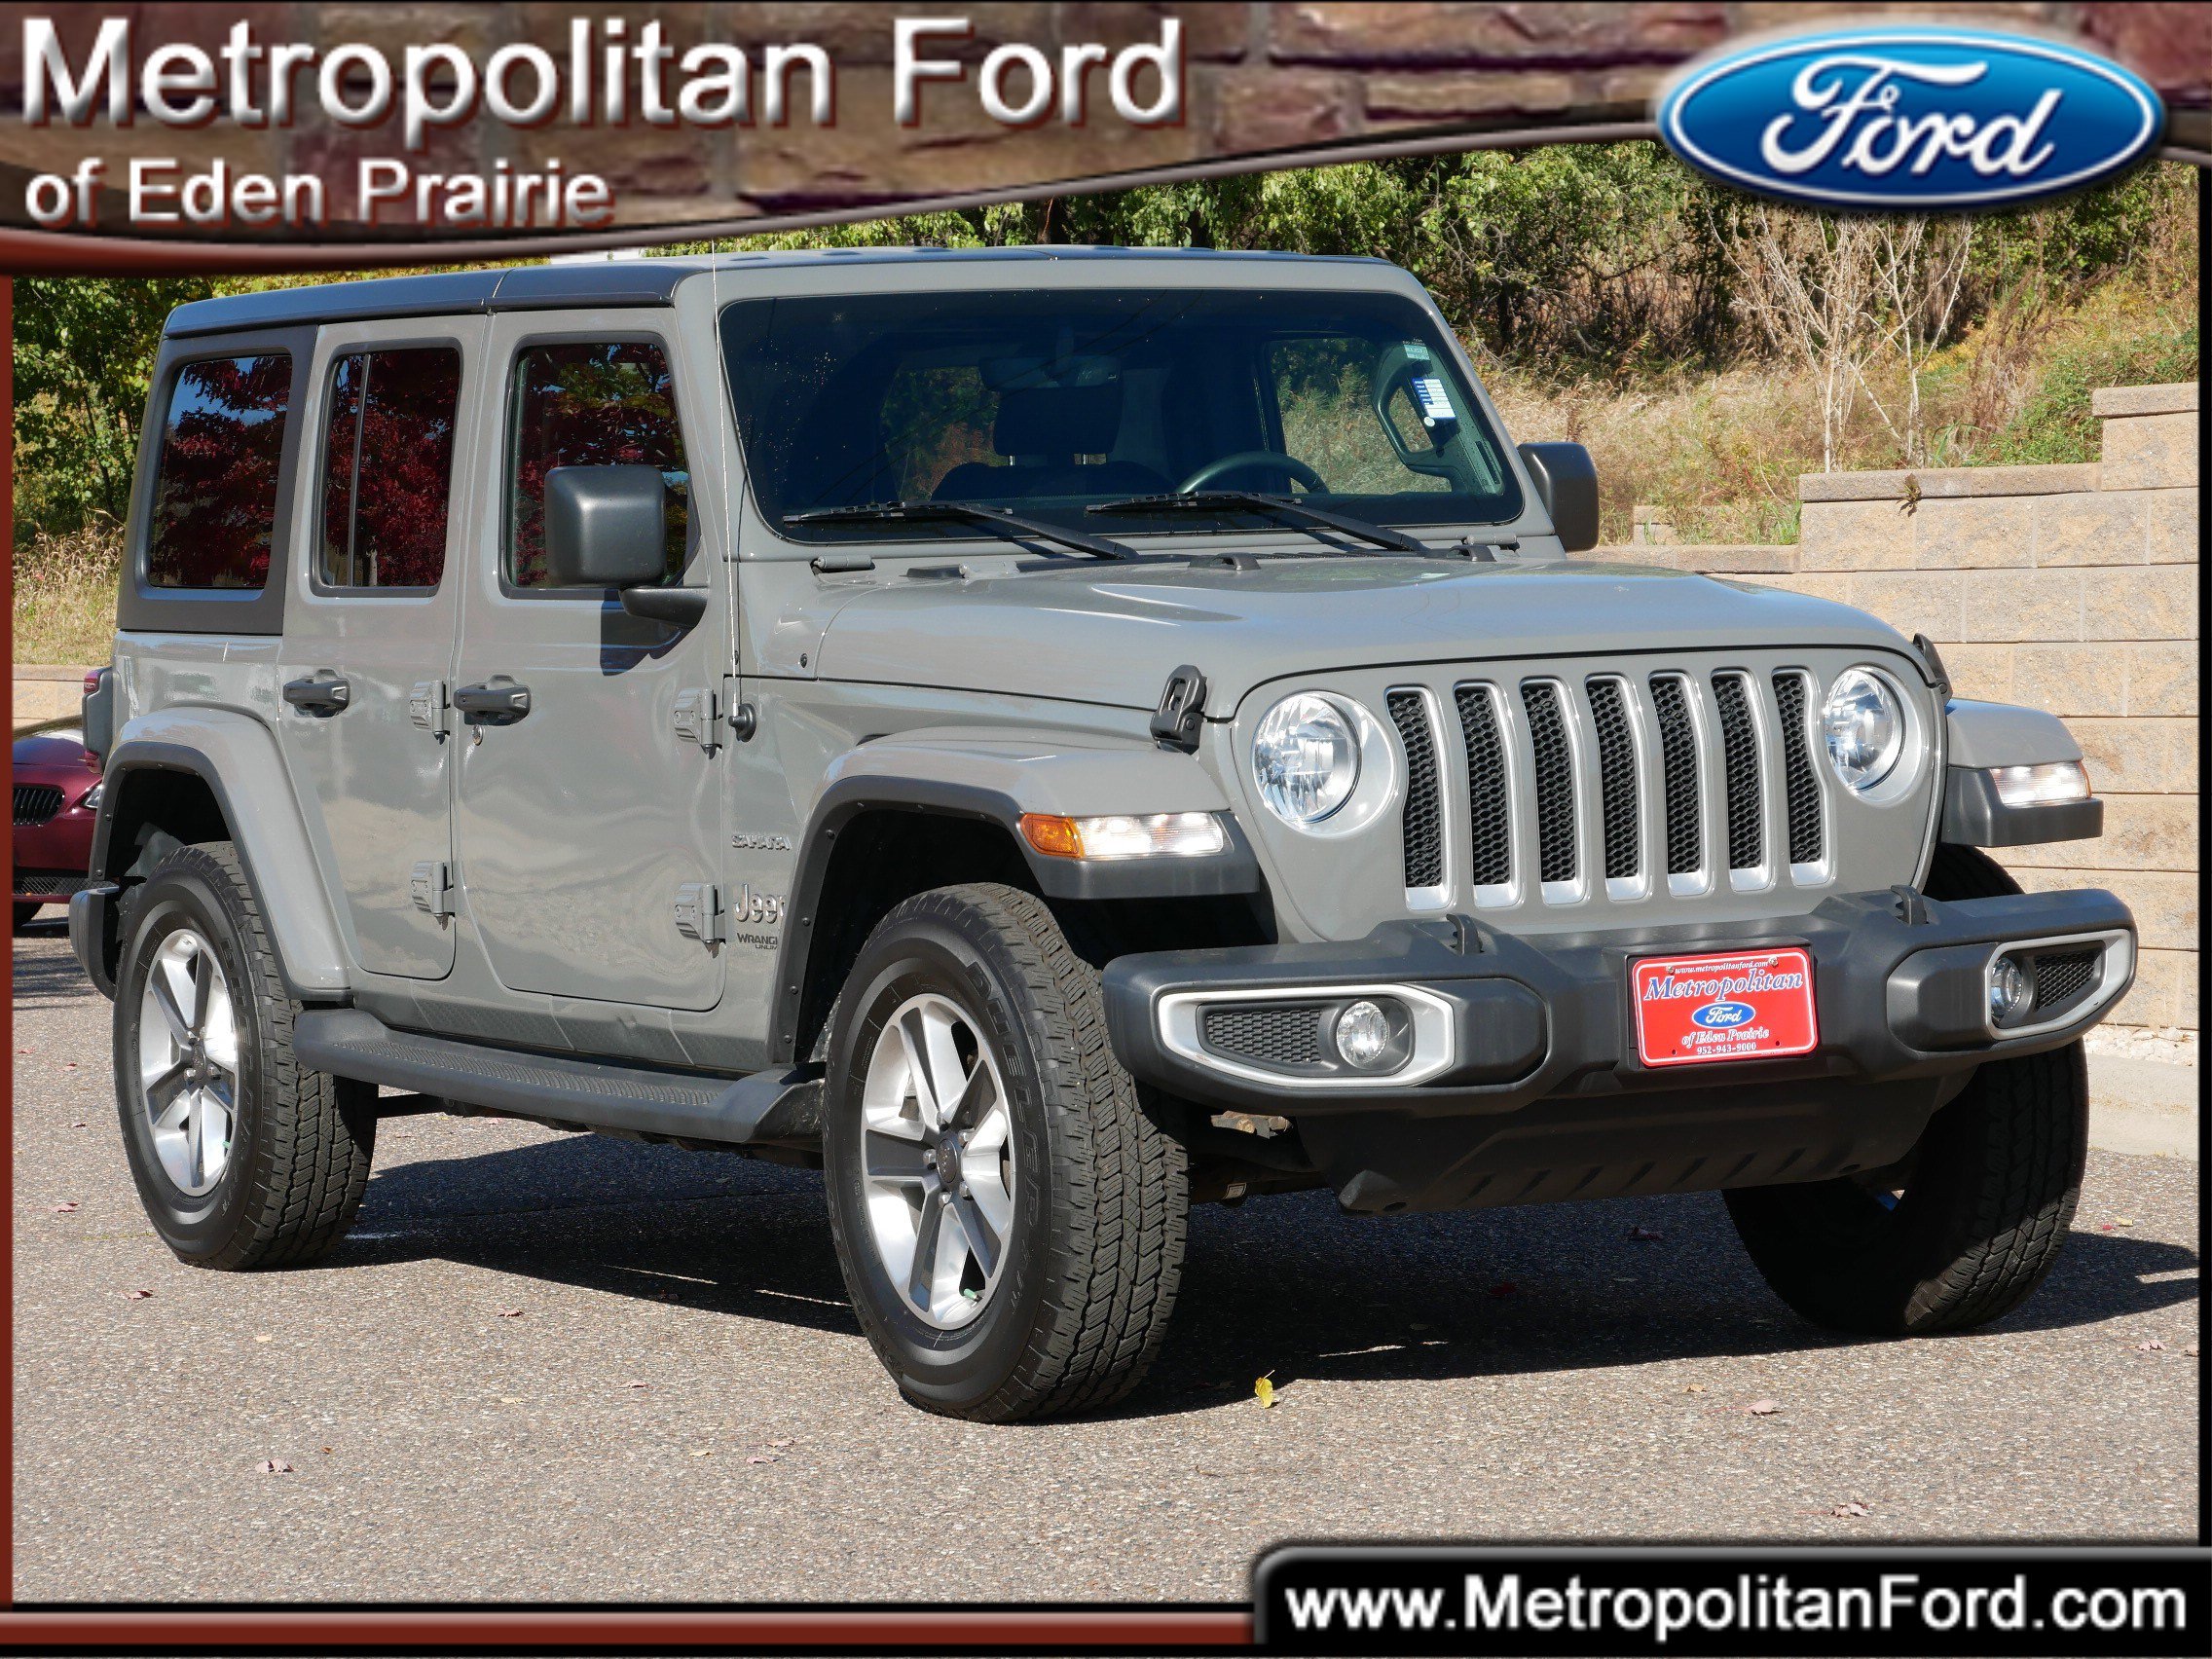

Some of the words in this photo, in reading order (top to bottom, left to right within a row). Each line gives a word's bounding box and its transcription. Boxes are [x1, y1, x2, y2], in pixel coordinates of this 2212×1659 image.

[1675, 960, 1769, 975] www.metropolitanford.com
[1643, 969, 1804, 1002] Metropolitan
[1705, 1006, 1743, 1024] Ford
[1681, 1032, 1696, 1049] of
[1696, 1031, 1726, 1045] Eden
[1727, 1026, 1770, 1042] Prairie
[1697, 1042, 1756, 1055] 952-943-9000
